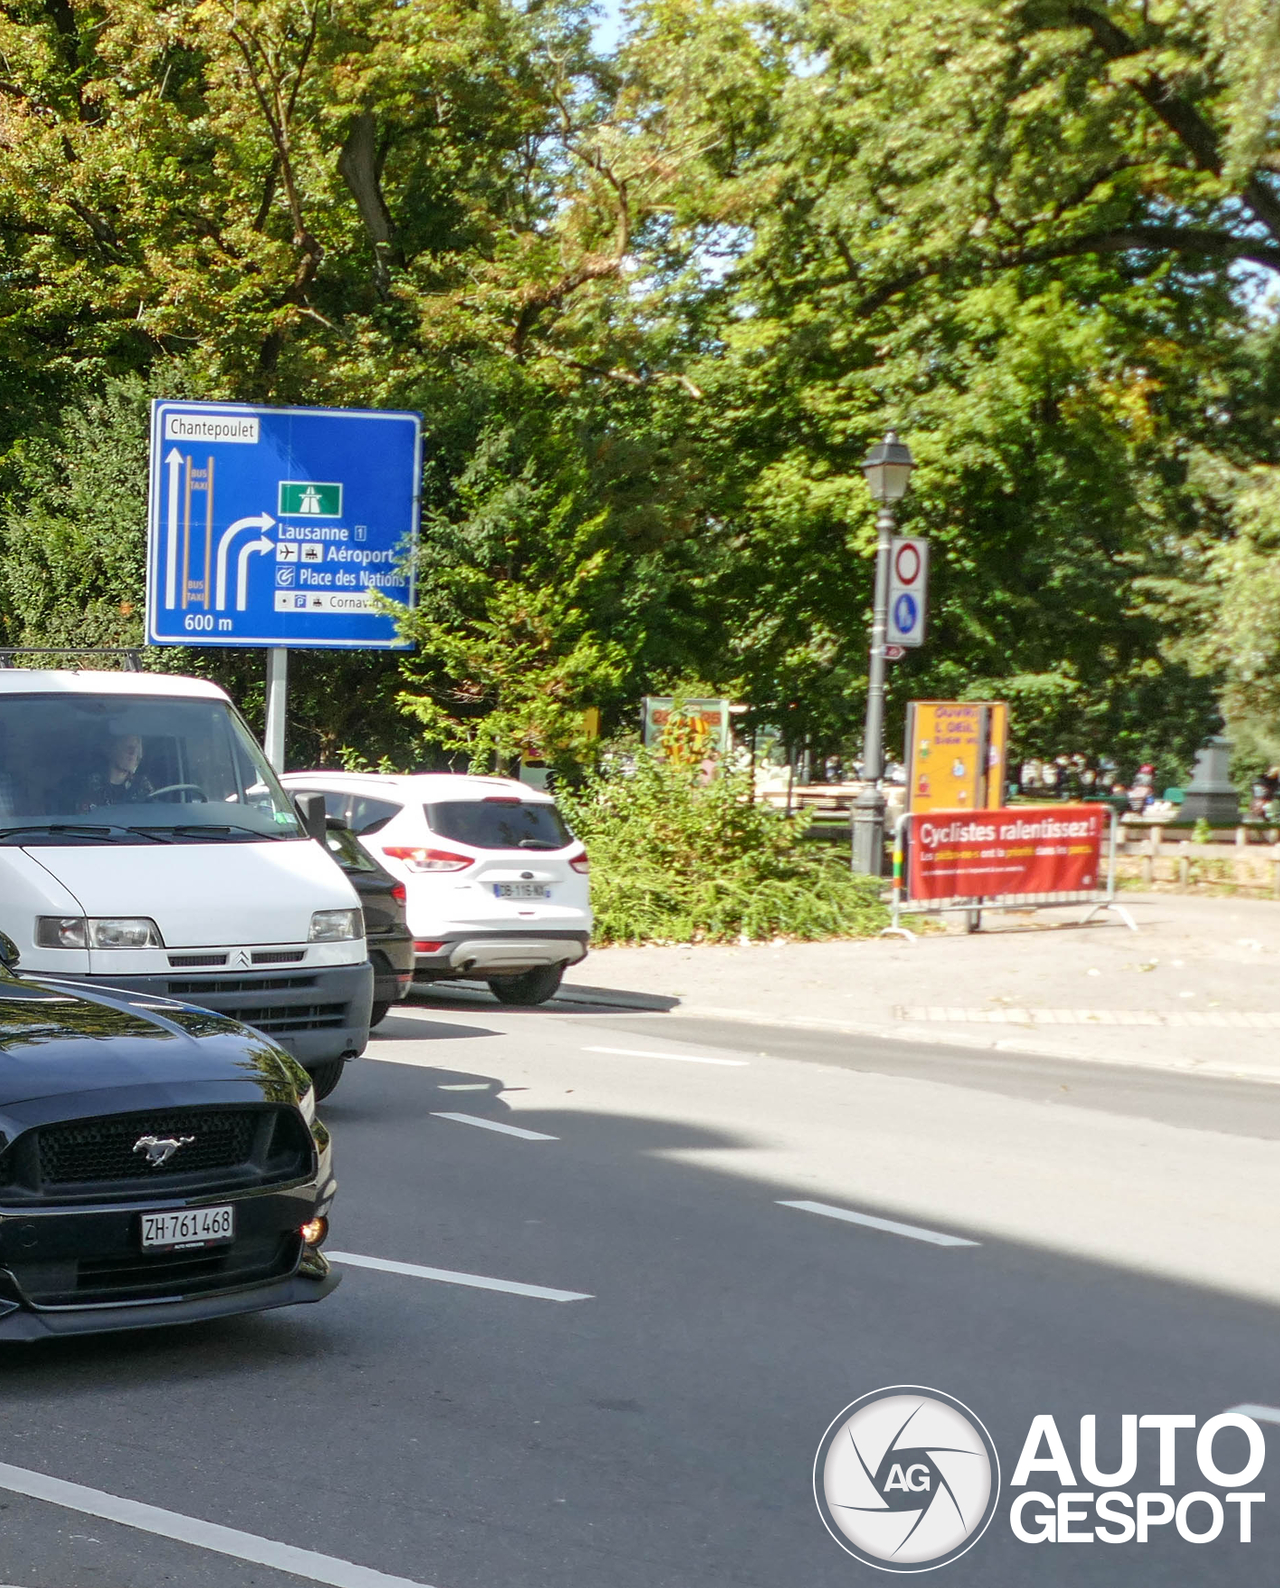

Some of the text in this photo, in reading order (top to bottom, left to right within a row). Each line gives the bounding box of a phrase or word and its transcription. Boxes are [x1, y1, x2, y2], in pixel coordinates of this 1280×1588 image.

[170, 418, 254, 440] Chantepoulet
[191, 469, 208, 478] BUS
[190, 481, 208, 490] TAXI
[278, 523, 349, 541] Lausanne
[327, 545, 394, 566] Aéroport
[187, 580, 204, 590] BUS
[300, 568, 406, 587] Place des Nations
[186, 592, 204, 602] TAXI
[184, 614, 232, 631] 600 m
[921, 817, 1096, 848] Cyclistes ralentissez!
